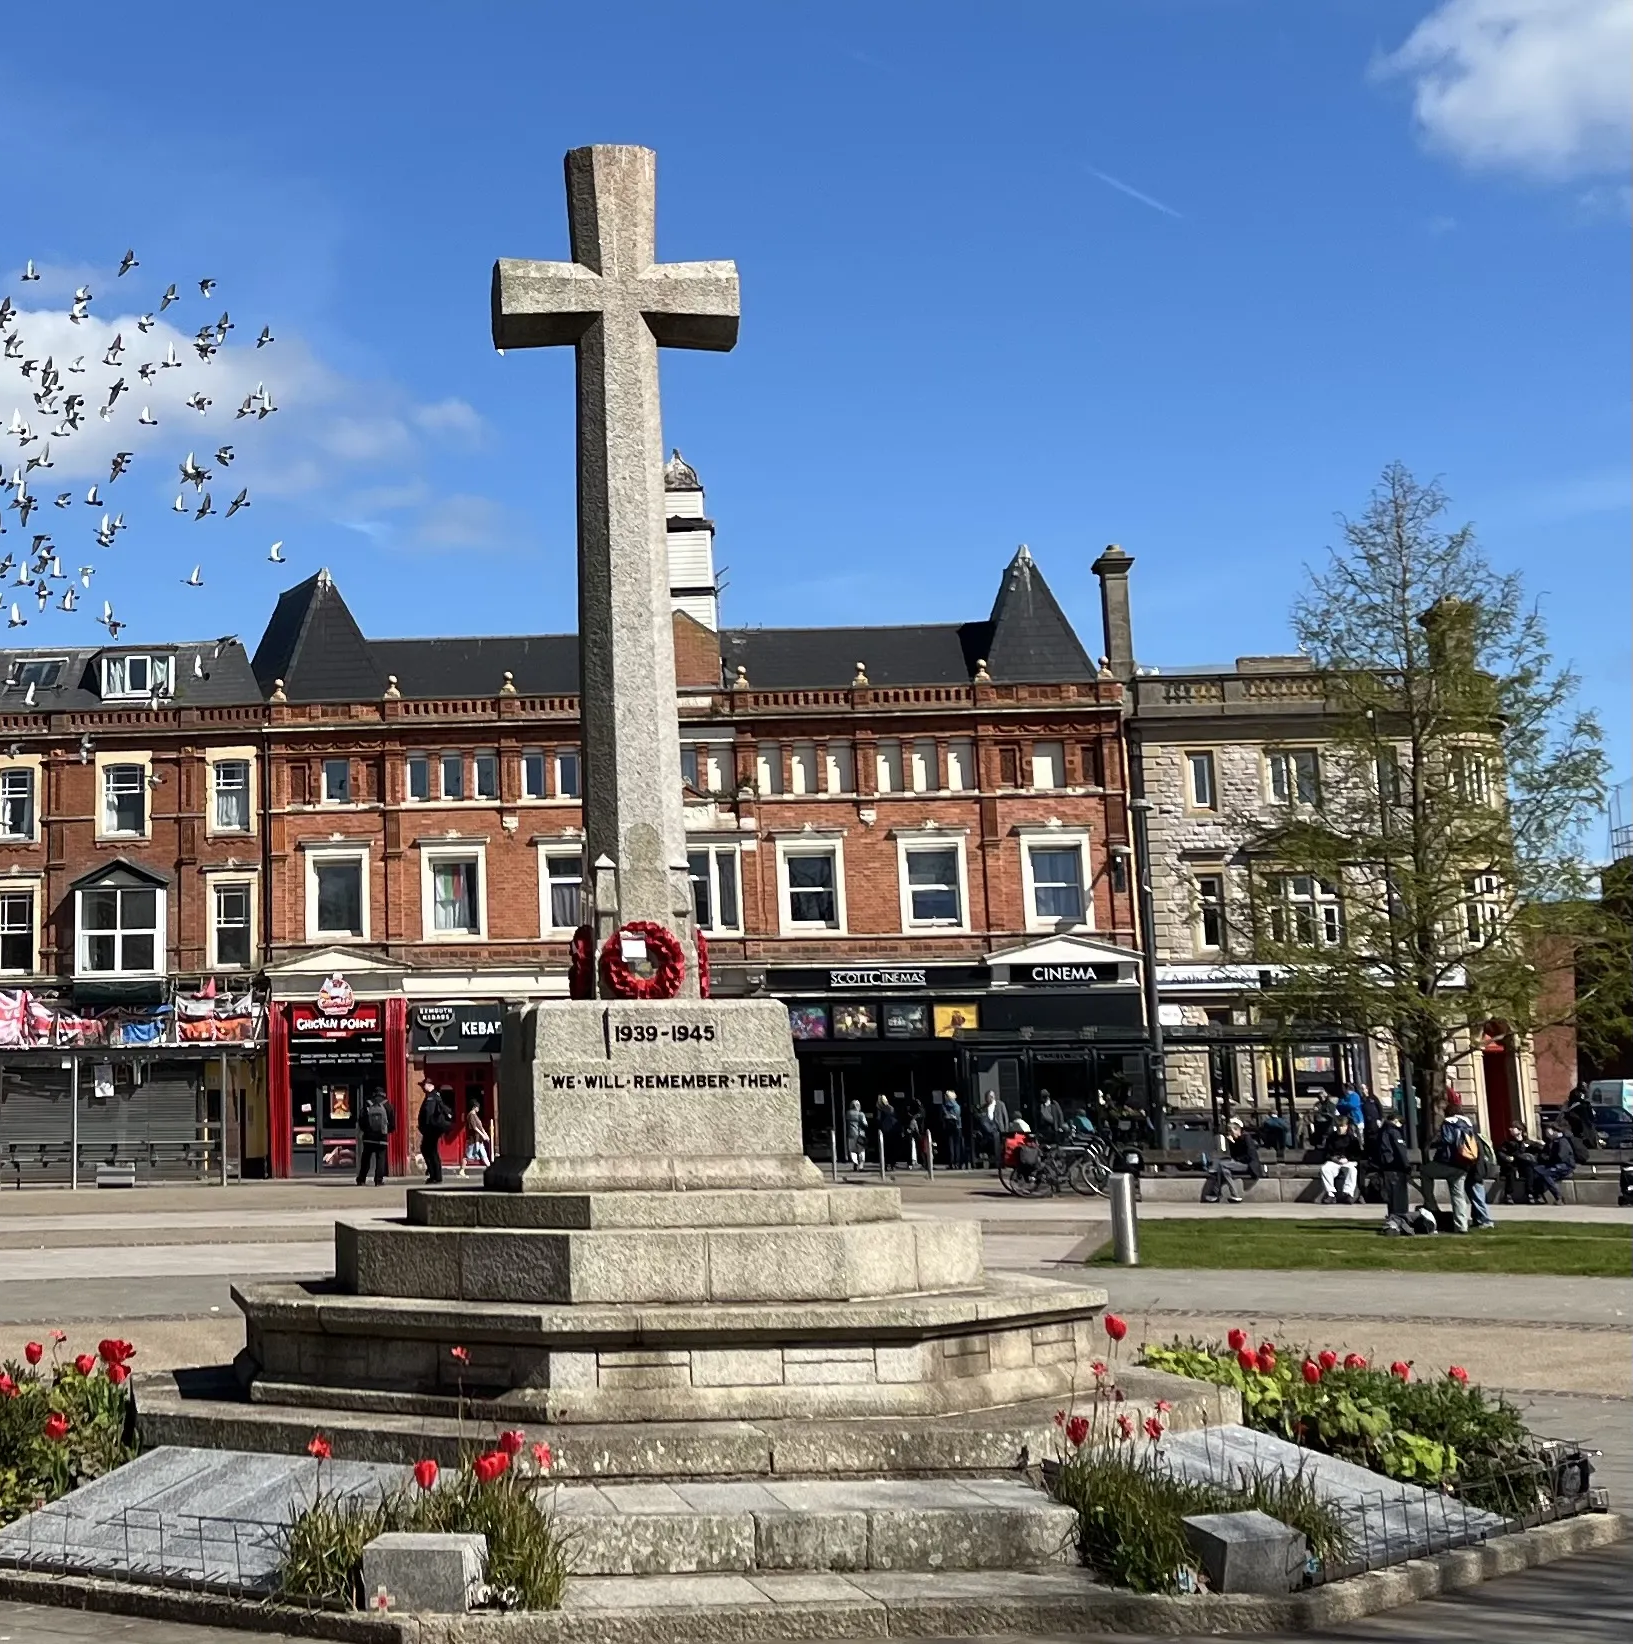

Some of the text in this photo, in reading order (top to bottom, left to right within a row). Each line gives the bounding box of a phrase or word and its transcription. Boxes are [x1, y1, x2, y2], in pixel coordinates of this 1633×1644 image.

[1032, 966, 1097, 981] CINEMA
[340, 1018, 376, 1029] POINT
[461, 1021, 503, 1035] KEBAB
[585, 1075, 625, 1089] WILL
[633, 1075, 730, 1089] REMEMBER
